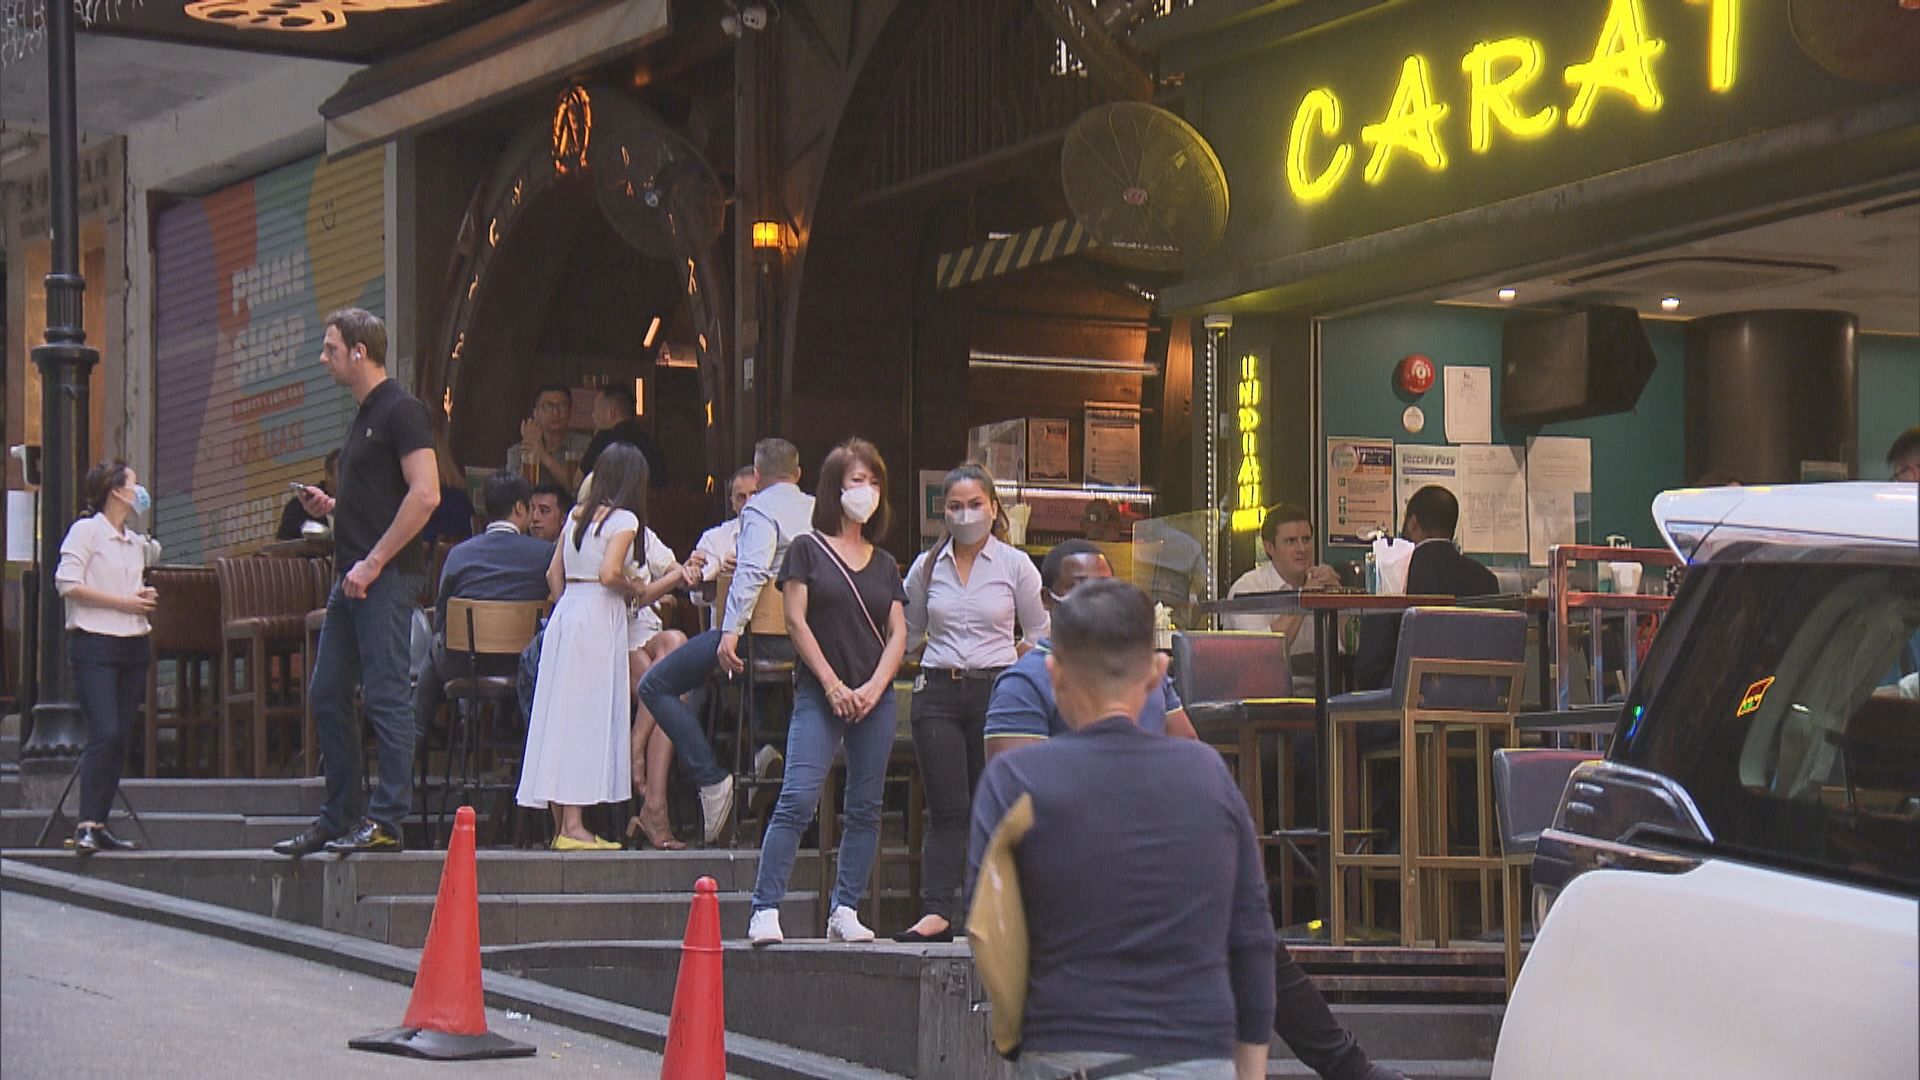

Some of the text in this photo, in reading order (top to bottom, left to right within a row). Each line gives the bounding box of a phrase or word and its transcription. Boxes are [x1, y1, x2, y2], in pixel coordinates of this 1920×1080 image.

[232, 250, 304, 315] PRIME
[232, 313, 305, 386] SHOP
[232, 420, 304, 466] FOR LEASE
[1237, 353, 1262, 510] INDIAN
[1402, 453, 1434, 465] Vaccine
[1435, 454, 1456, 466] Pass
